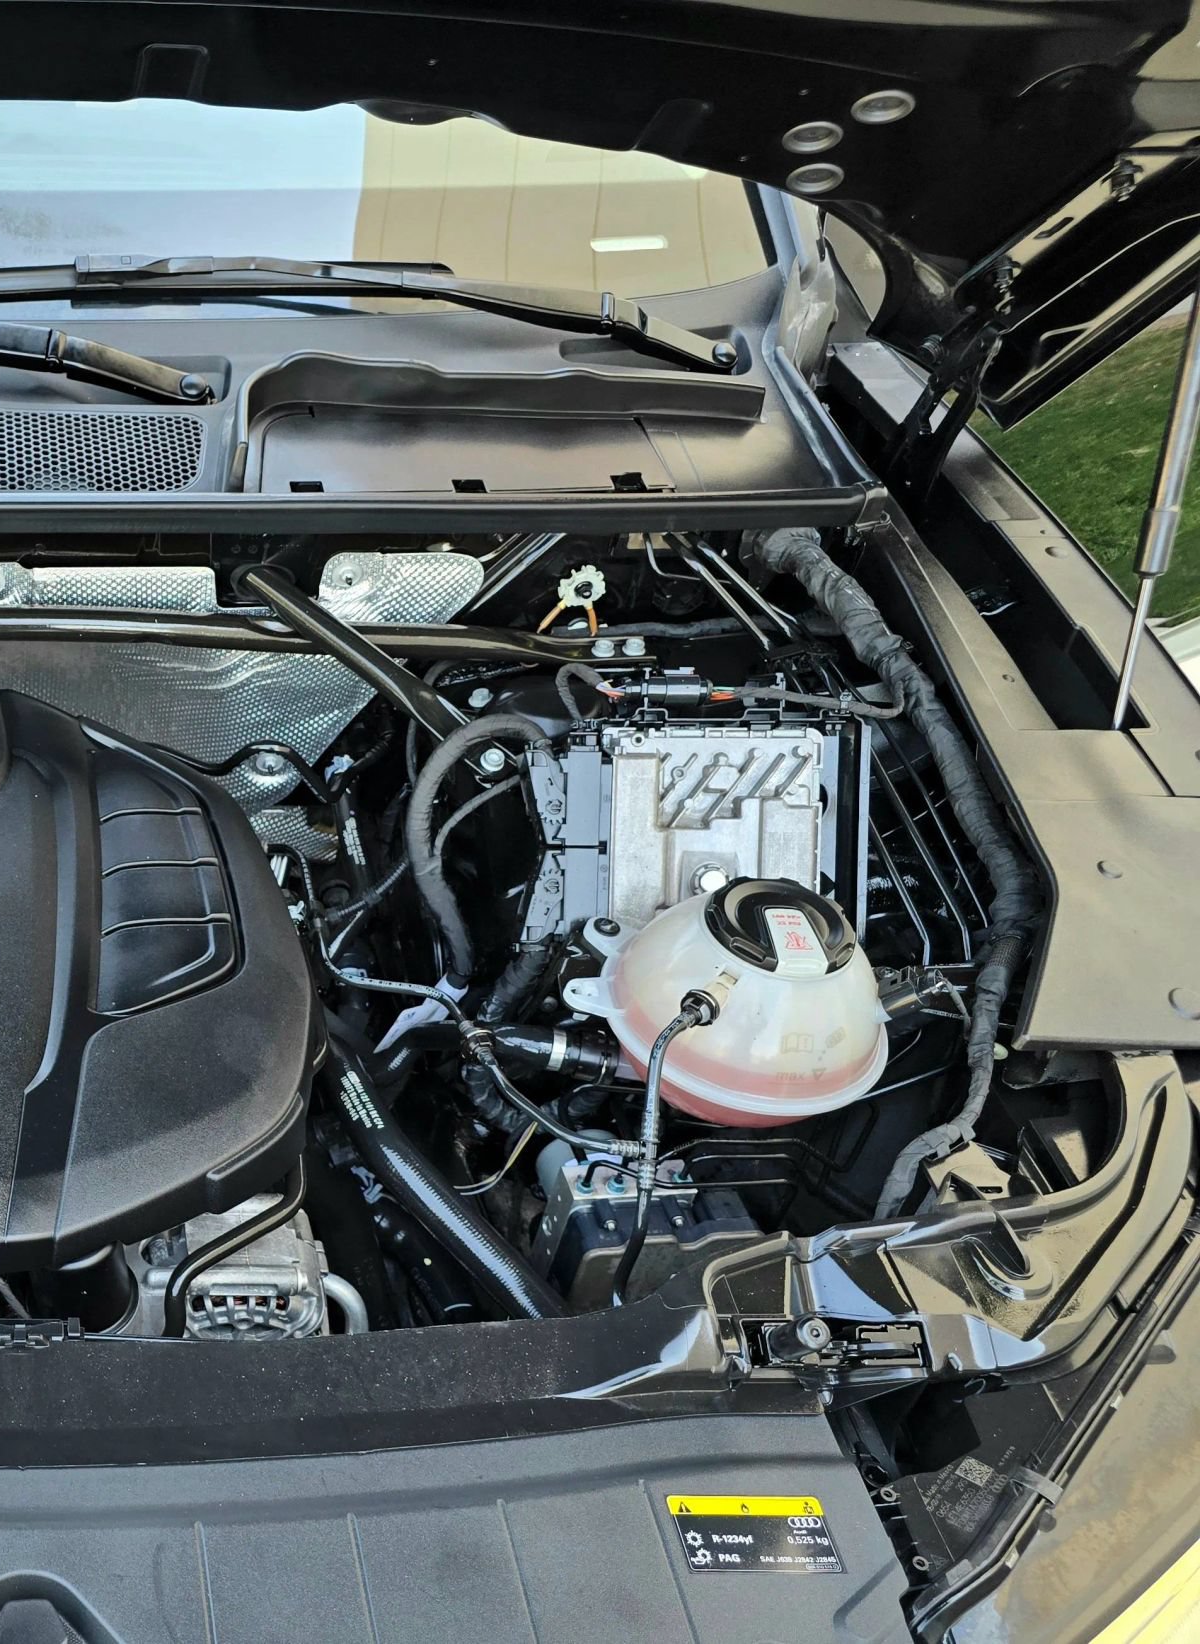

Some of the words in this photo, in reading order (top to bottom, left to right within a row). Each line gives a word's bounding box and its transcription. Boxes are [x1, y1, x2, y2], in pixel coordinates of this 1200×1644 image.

[712, 1535, 754, 1545] R-1234yf
[787, 1536, 814, 1544] 0,525
[815, 1536, 829, 1545] kg
[718, 1554, 741, 1562] PAG
